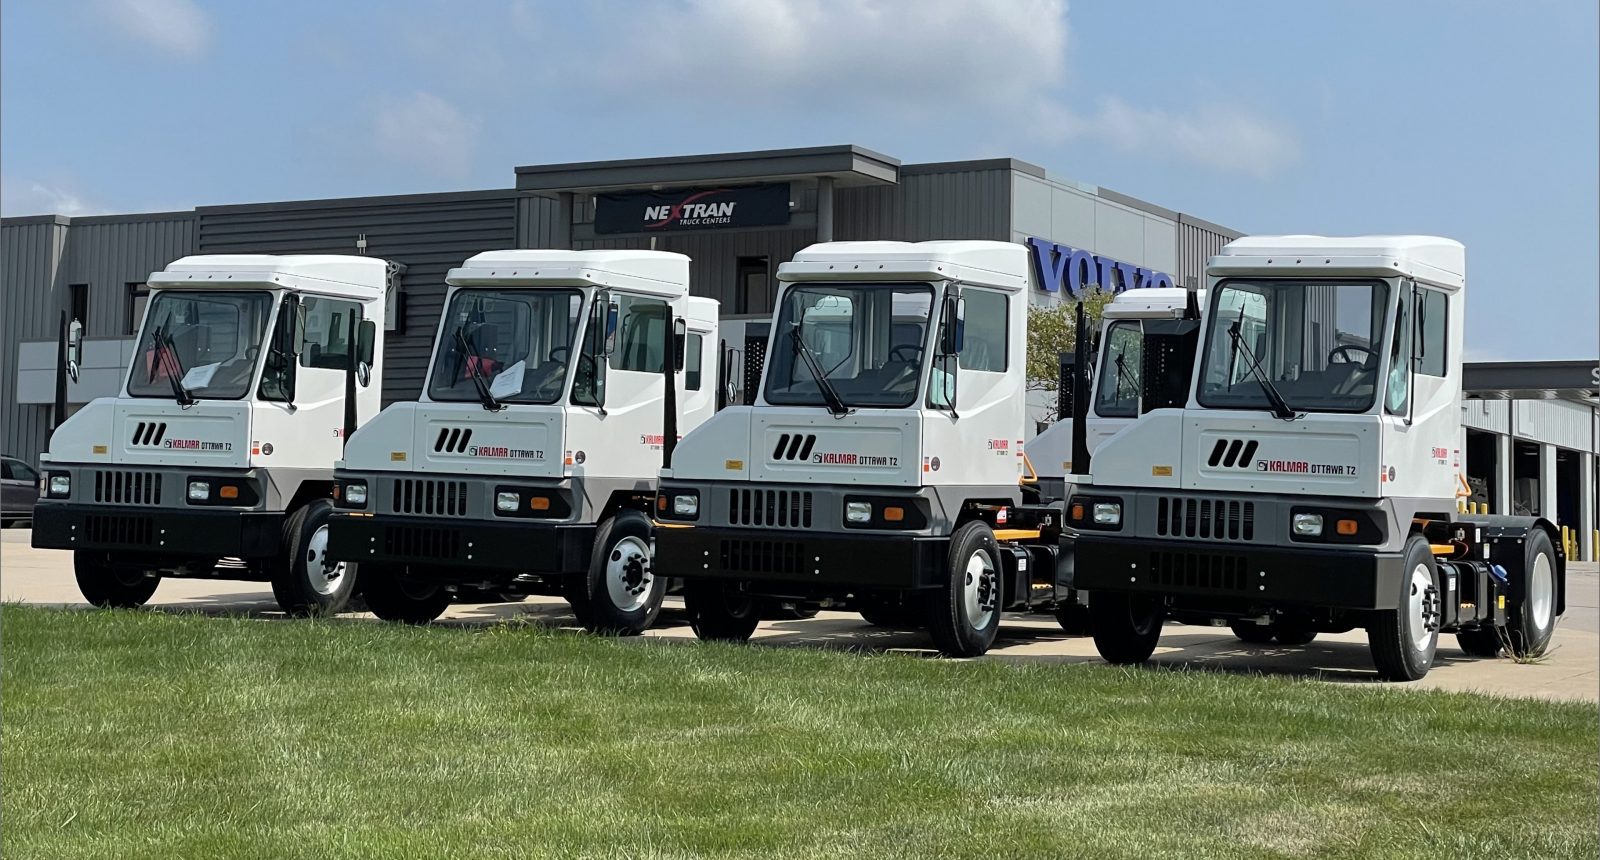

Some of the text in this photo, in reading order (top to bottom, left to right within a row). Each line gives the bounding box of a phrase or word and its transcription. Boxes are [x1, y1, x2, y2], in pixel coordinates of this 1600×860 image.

[644, 202, 736, 221] NEXTRAN
[679, 217, 731, 226] TRUCK CENTERS
[172, 439, 232, 450] KALMAR OTTAWA T2
[478, 446, 544, 459] KALMAR OTTAWA T2
[823, 453, 898, 466] KALMAR OTTAWA T2
[1269, 460, 1356, 475] KALMAR OTTAWA T2
